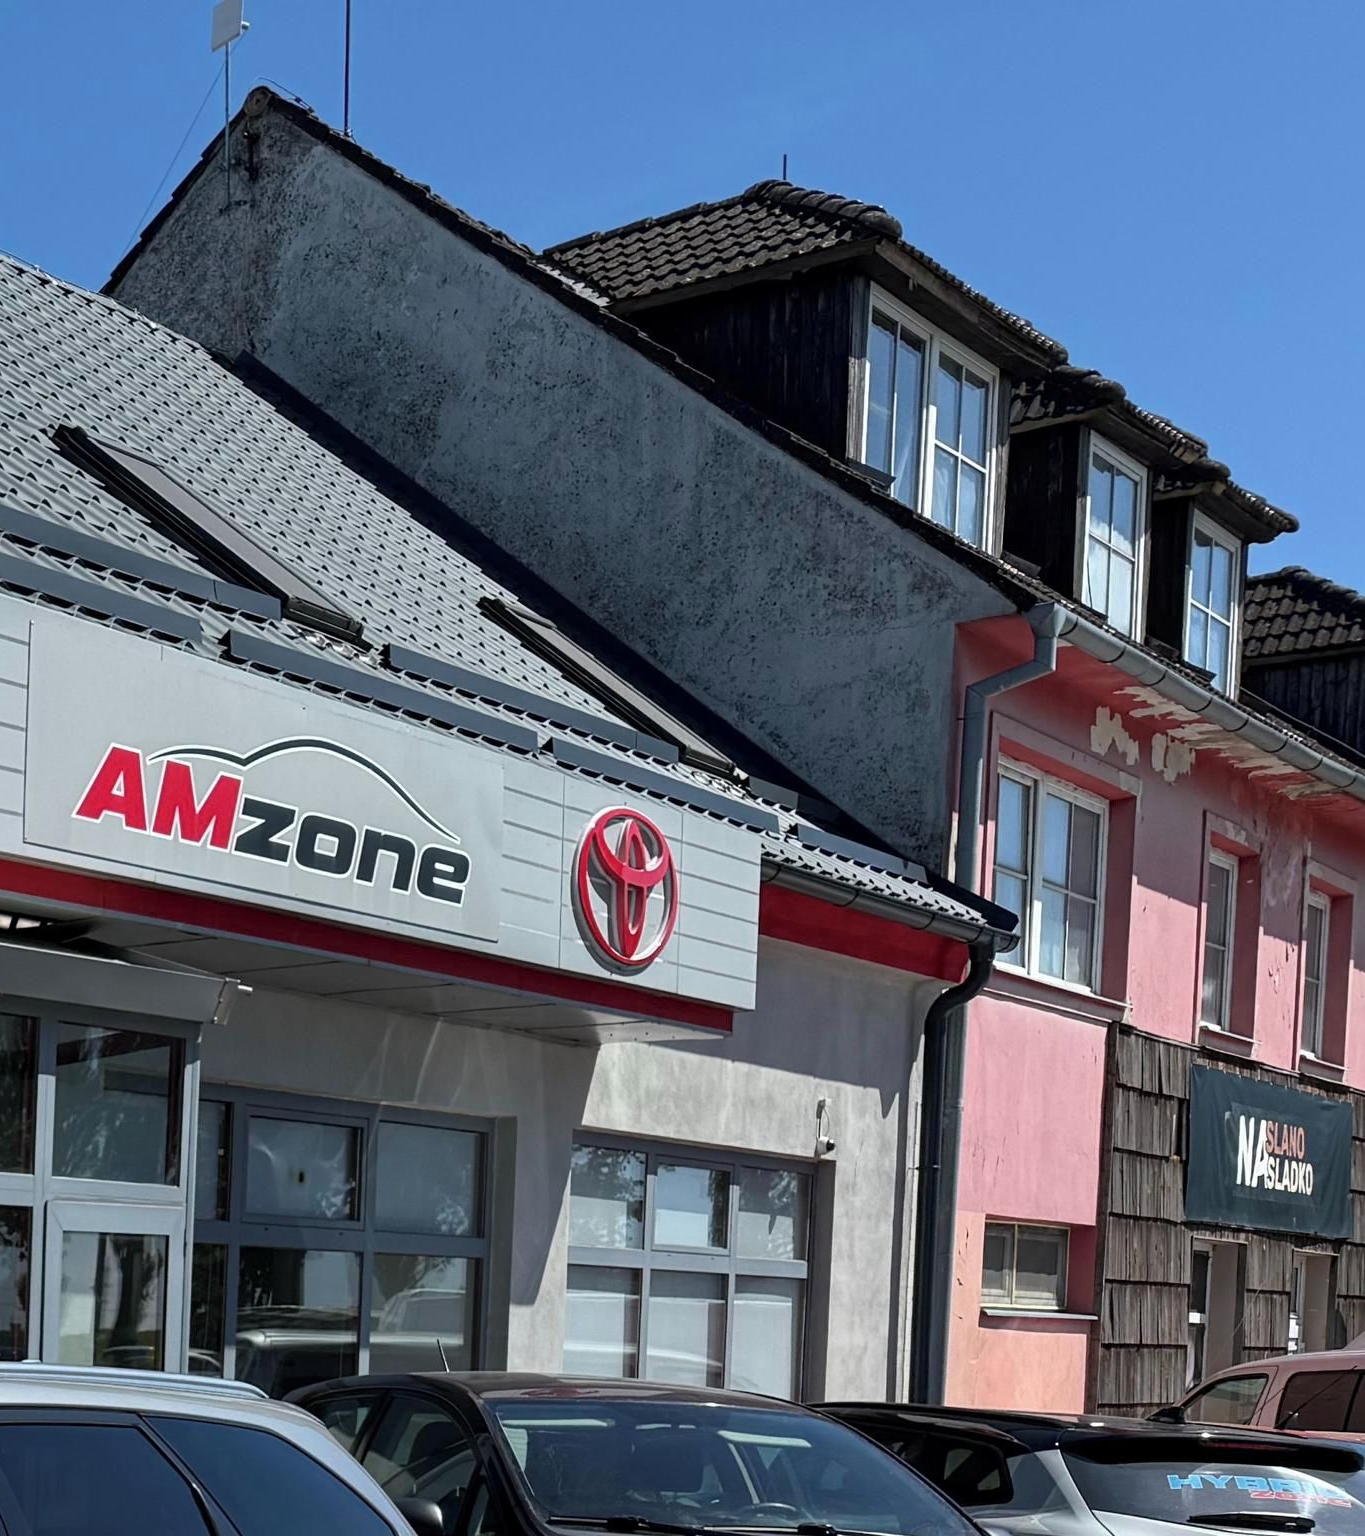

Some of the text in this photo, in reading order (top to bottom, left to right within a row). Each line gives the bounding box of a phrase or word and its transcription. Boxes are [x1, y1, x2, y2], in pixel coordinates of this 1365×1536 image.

[72, 742, 471, 907] AMzone
[1236, 1115, 1269, 1188] NA
[1266, 1120, 1305, 1160] SLANO
[1267, 1156, 1314, 1196] SLADKO
[1167, 1474, 1350, 1499] HYBRID
